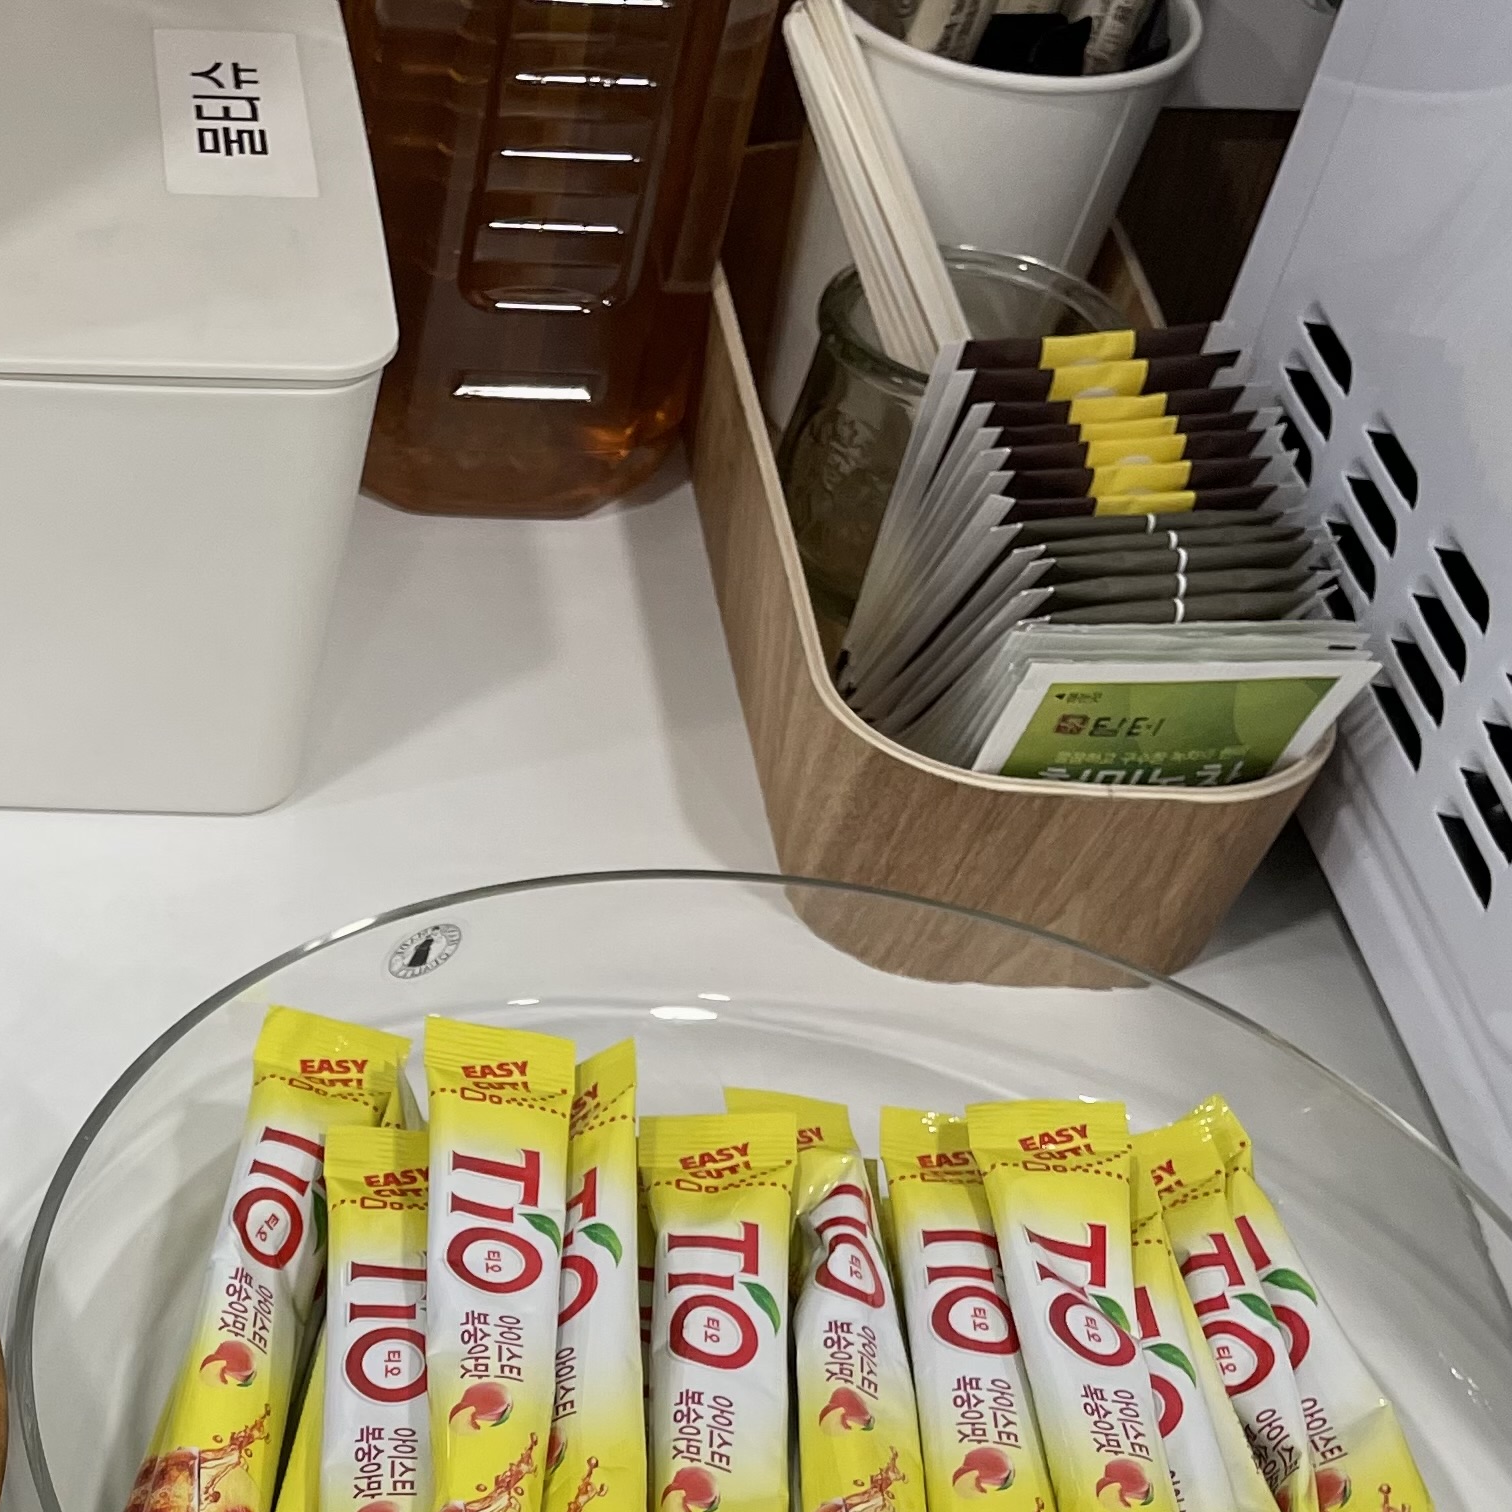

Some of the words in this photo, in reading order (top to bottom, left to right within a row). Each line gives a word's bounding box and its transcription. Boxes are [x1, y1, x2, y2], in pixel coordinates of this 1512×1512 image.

[190, 61, 269, 157] 물티슈
[299, 1058, 369, 1076] EASY
[461, 1060, 529, 1080] EASY
[678, 1141, 751, 1172] EASY
[1017, 1122, 1090, 1153] EASY
[255, 1211, 279, 1243] 티오
[372, 1187, 429, 1199] CUT
[446, 1148, 544, 1295] TIO
[484, 1248, 502, 1274] 티오
[666, 1220, 760, 1371] TIO
[848, 1254, 864, 1281] 티오
[218, 1266, 255, 1341] 복숭아맛
[245, 1284, 275, 1356] 아이스티
[704, 1316, 722, 1344] 티오
[970, 1306, 989, 1332] 티오
[1085, 1315, 1103, 1344] 티오
[384, 1348, 402, 1379] 티오
[459, 1309, 491, 1380] 복숭아맛
[493, 1313, 522, 1383] 아이스티
[821, 1319, 855, 1385] 복숭아맛
[855, 1324, 880, 1401] 아이스티
[1214, 1345, 1238, 1376] 티오
[671, 1388, 705, 1463] 복숭아맛
[705, 1394, 734, 1475] 아이스티
[952, 1374, 987, 1445] 복숭아맛
[993, 1377, 1022, 1450] 아이스티
[1080, 1383, 1121, 1458] 복숭아맛
[1113, 1388, 1151, 1463] 아이스티
[353, 1425, 386, 1500] 복숭아맛
[390, 1427, 418, 1498] 아이스티
